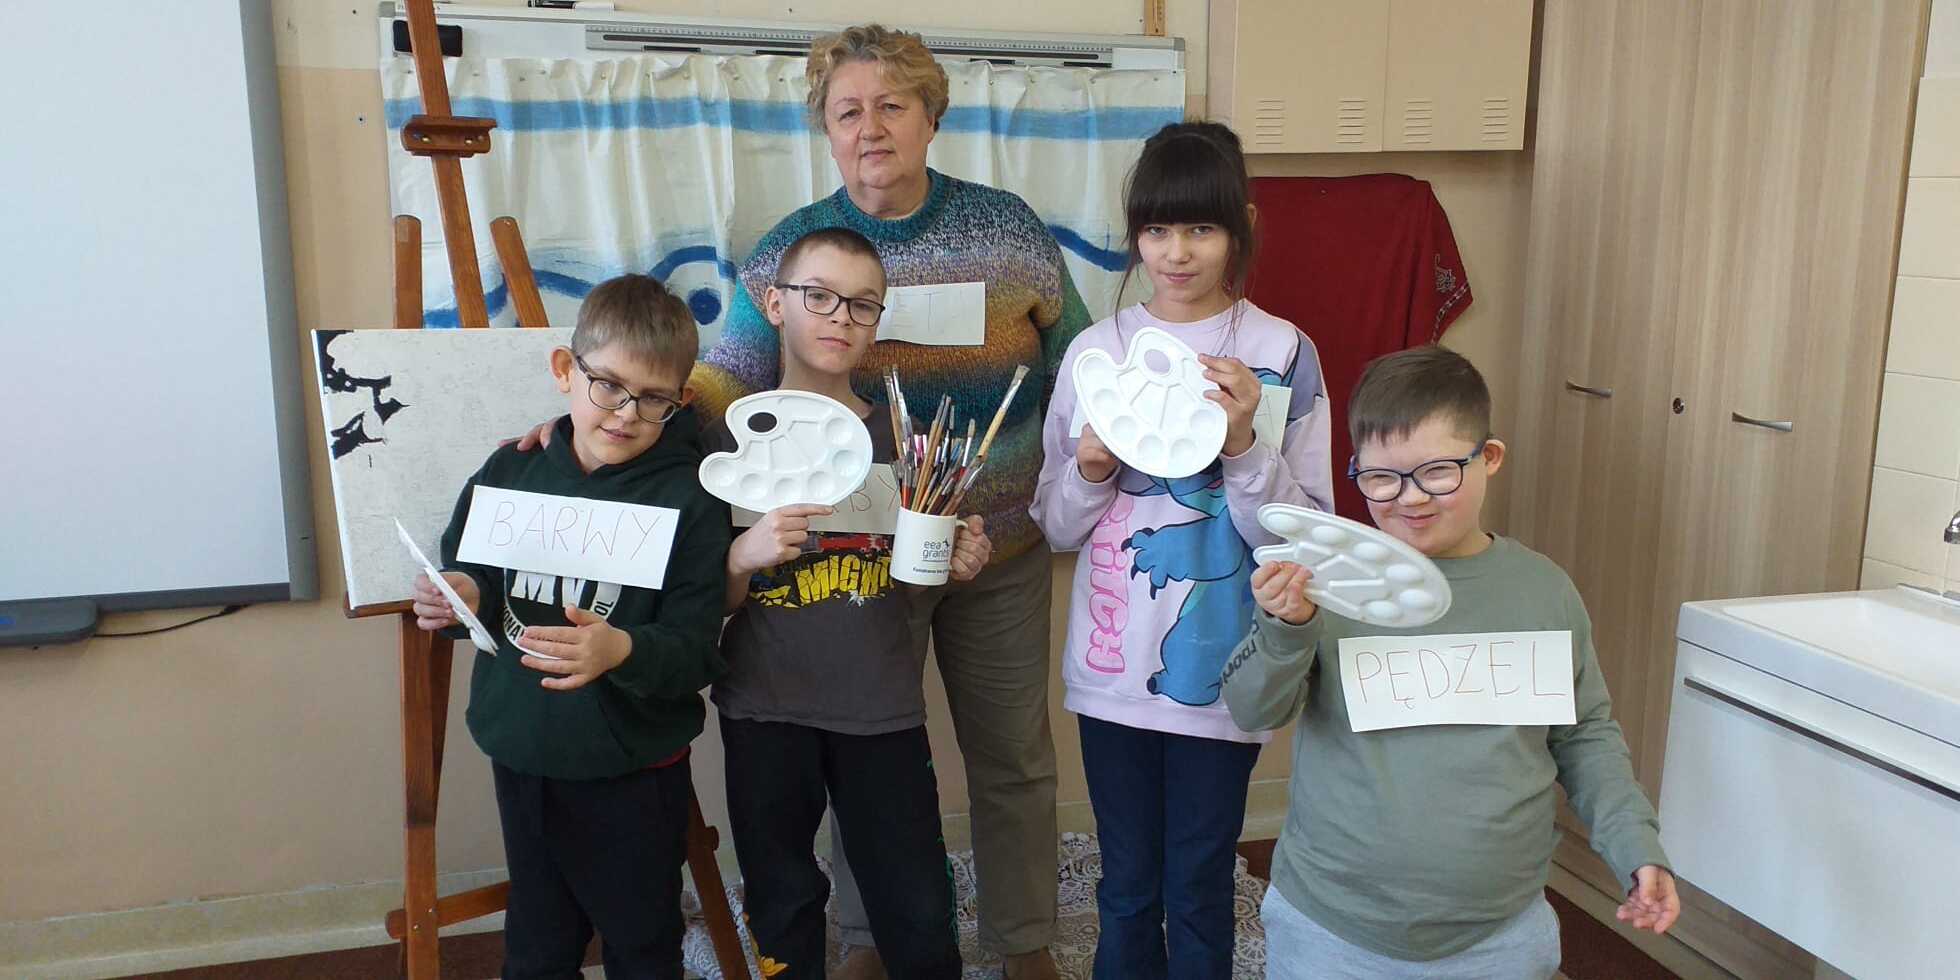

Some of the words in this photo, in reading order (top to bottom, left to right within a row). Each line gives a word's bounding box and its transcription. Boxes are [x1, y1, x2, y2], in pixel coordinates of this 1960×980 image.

[487, 500, 661, 561] BARWY
[924, 540, 942, 550] eea
[1355, 640, 1567, 710] PĘDZEL
